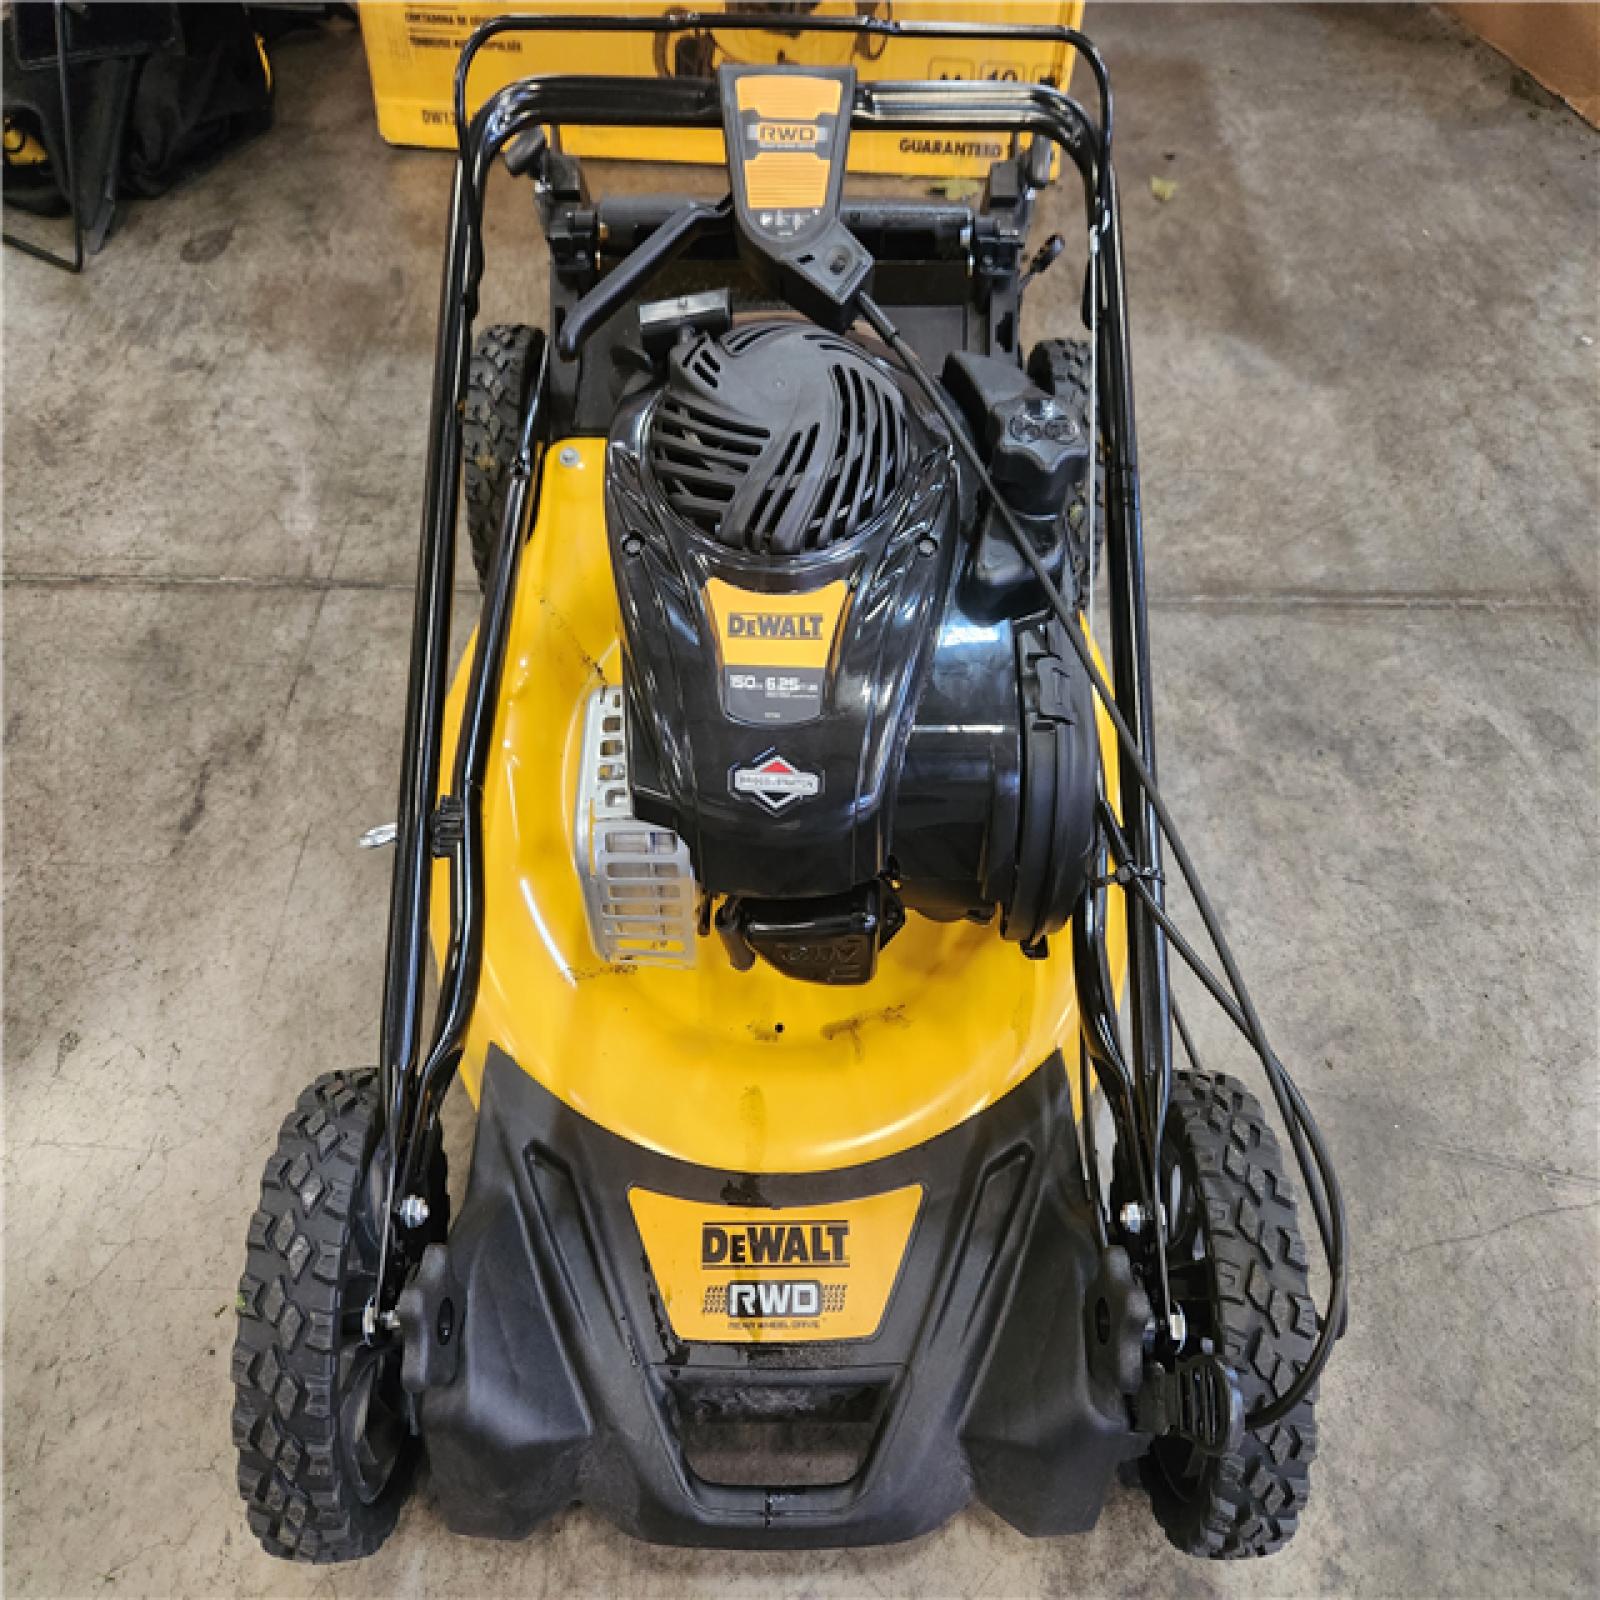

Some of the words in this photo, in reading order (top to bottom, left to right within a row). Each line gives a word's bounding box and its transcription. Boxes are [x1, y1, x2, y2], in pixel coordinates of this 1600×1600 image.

[759, 125, 816, 141] RWD
[899, 137, 1001, 158] GUARANTEED
[727, 612, 824, 638] DEWALT
[702, 1222, 849, 1266] DEWALT
[729, 1284, 818, 1316] RWD
